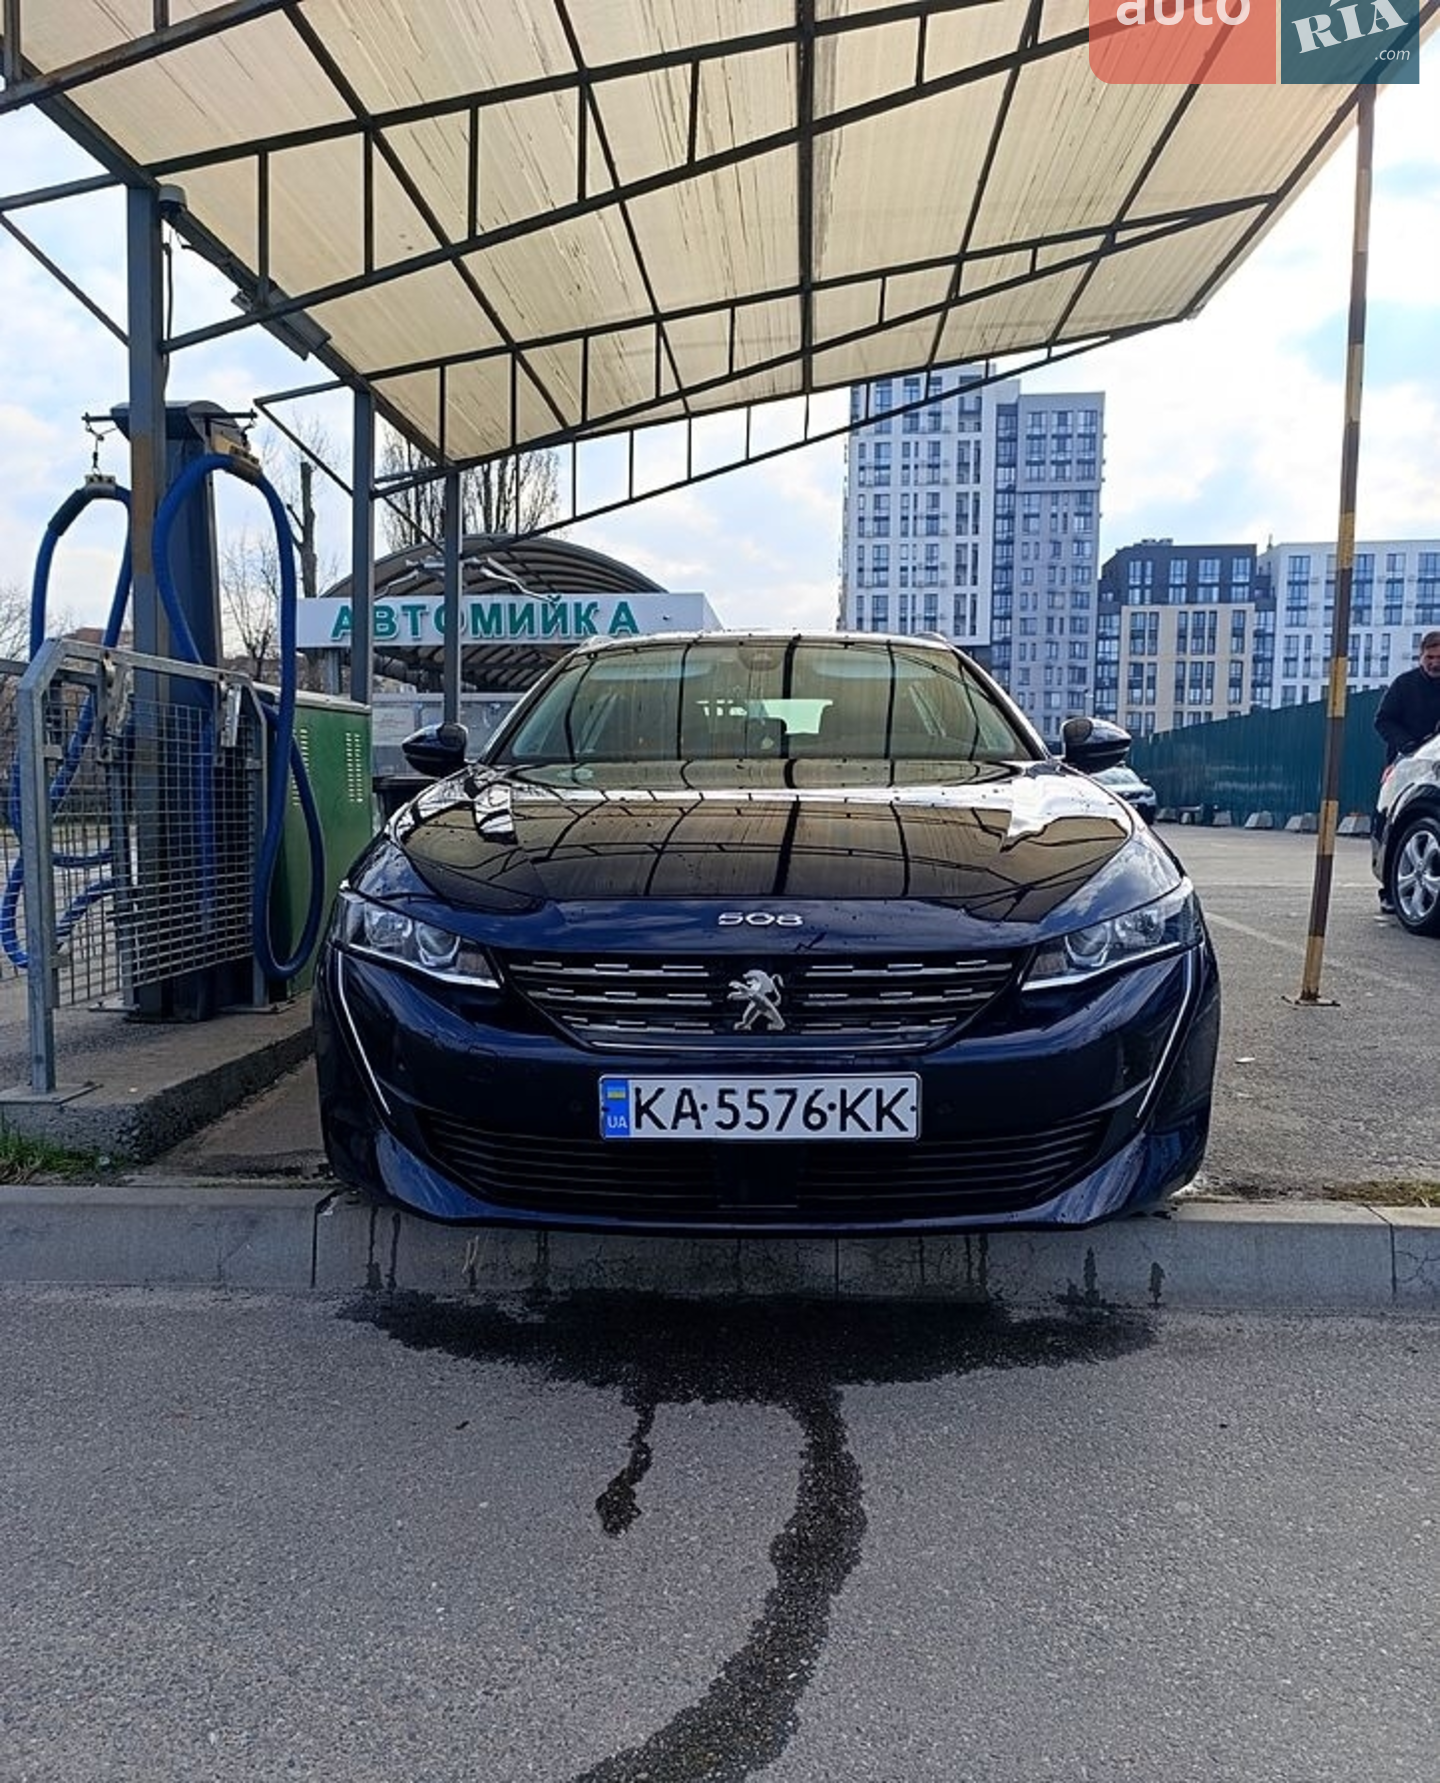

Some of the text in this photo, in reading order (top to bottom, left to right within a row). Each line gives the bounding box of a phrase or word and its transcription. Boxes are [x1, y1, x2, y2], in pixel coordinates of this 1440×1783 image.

[718, 911, 803, 927] 508
[714, 1087, 829, 1132] 5576
[607, 1115, 628, 1129] UA
